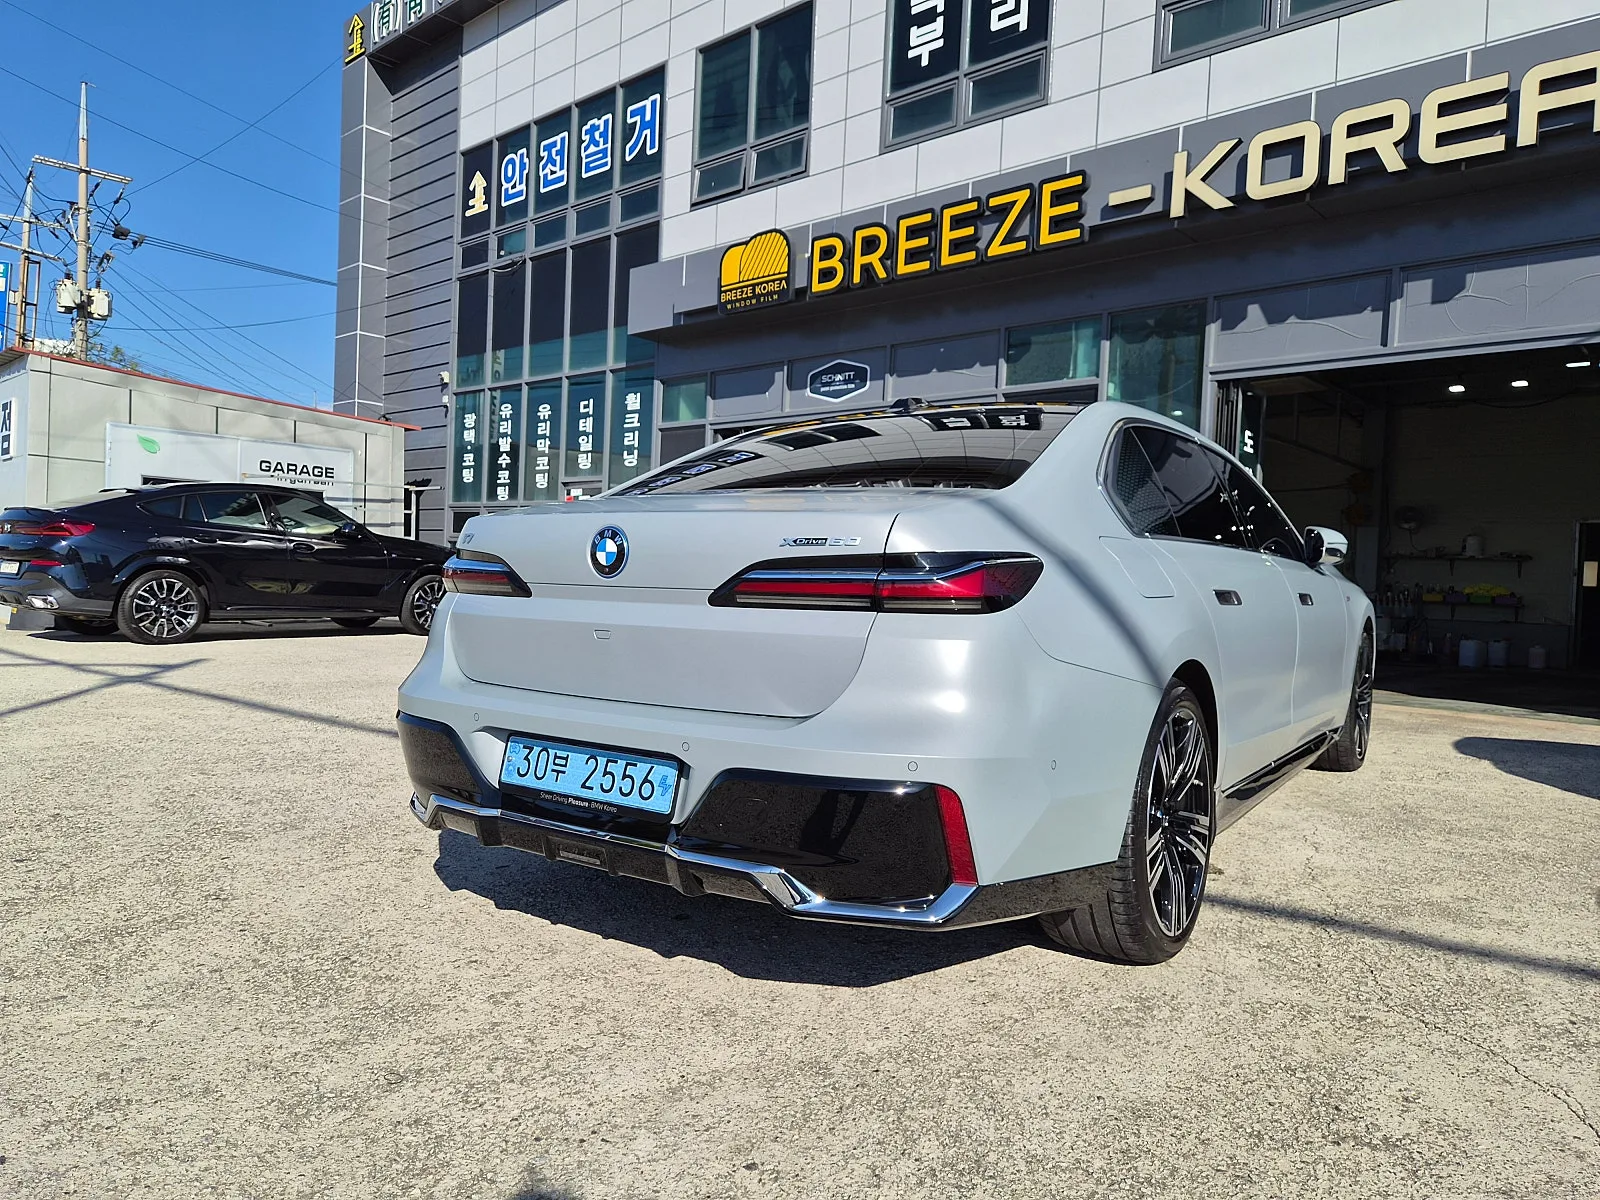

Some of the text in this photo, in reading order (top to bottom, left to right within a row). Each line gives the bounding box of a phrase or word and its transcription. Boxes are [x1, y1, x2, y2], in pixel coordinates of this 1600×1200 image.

[501, 94, 661, 208] 안전철거
[811, 174, 1083, 293] BREEZE
[1169, 50, 1600, 219] KOREA
[720, 280, 787, 302] BREEZE KOREA
[726, 294, 778, 310] WINDOW FILM
[496, 403, 513, 501] 유리발수코팅
[535, 403, 551, 489] 유리막코팅
[577, 398, 594, 470] 디테일링
[622, 392, 641, 467] 휠크리닝
[259, 459, 335, 479] GARAGE
[594, 529, 623, 545] BMW
[516, 745, 655, 801] 30부 2556
[568, 797, 589, 808] Pleasure
[590, 801, 603, 810] BMW
